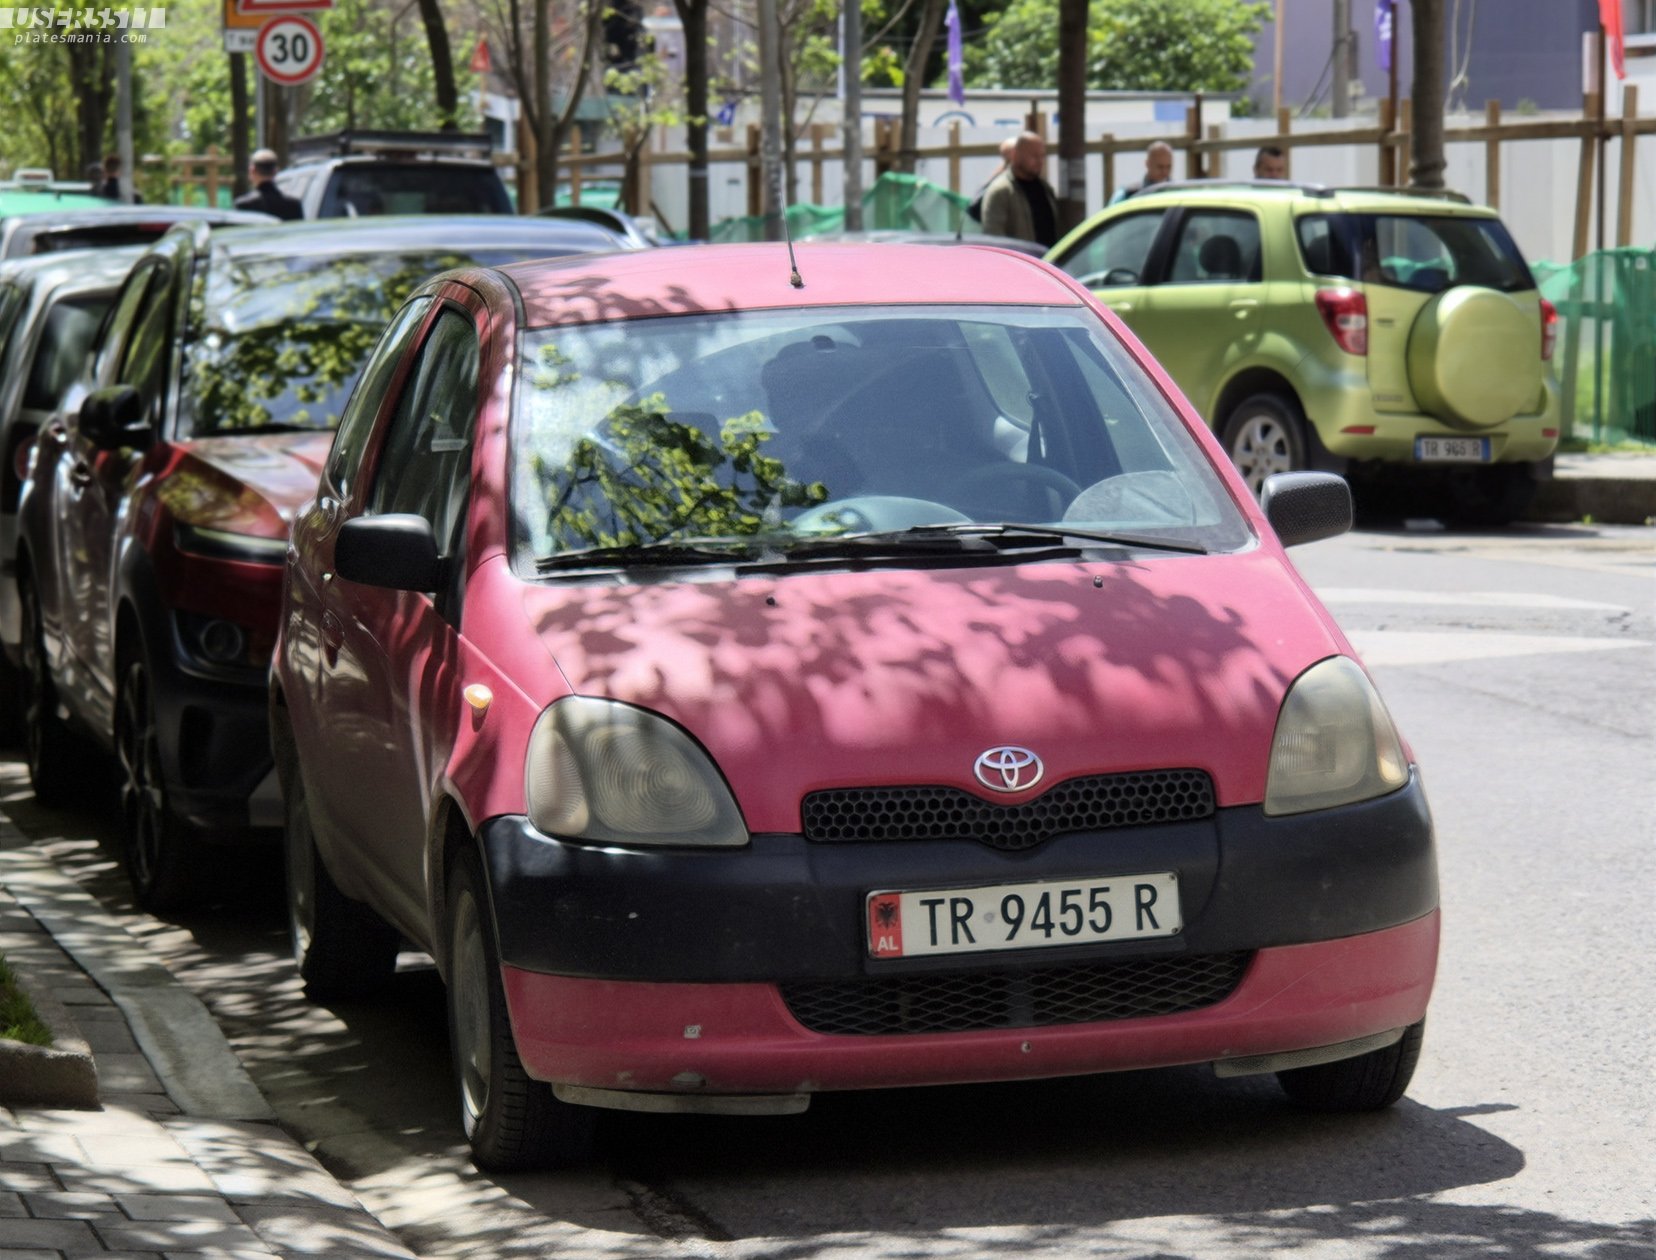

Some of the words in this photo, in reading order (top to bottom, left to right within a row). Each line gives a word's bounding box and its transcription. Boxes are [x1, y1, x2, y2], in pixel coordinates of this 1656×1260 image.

[271, 33, 308, 63] 30
[919, 897, 976, 946] TR
[1000, 886, 1113, 942] 9455
[1134, 883, 1160, 931] R
[877, 936, 899, 951] AL
